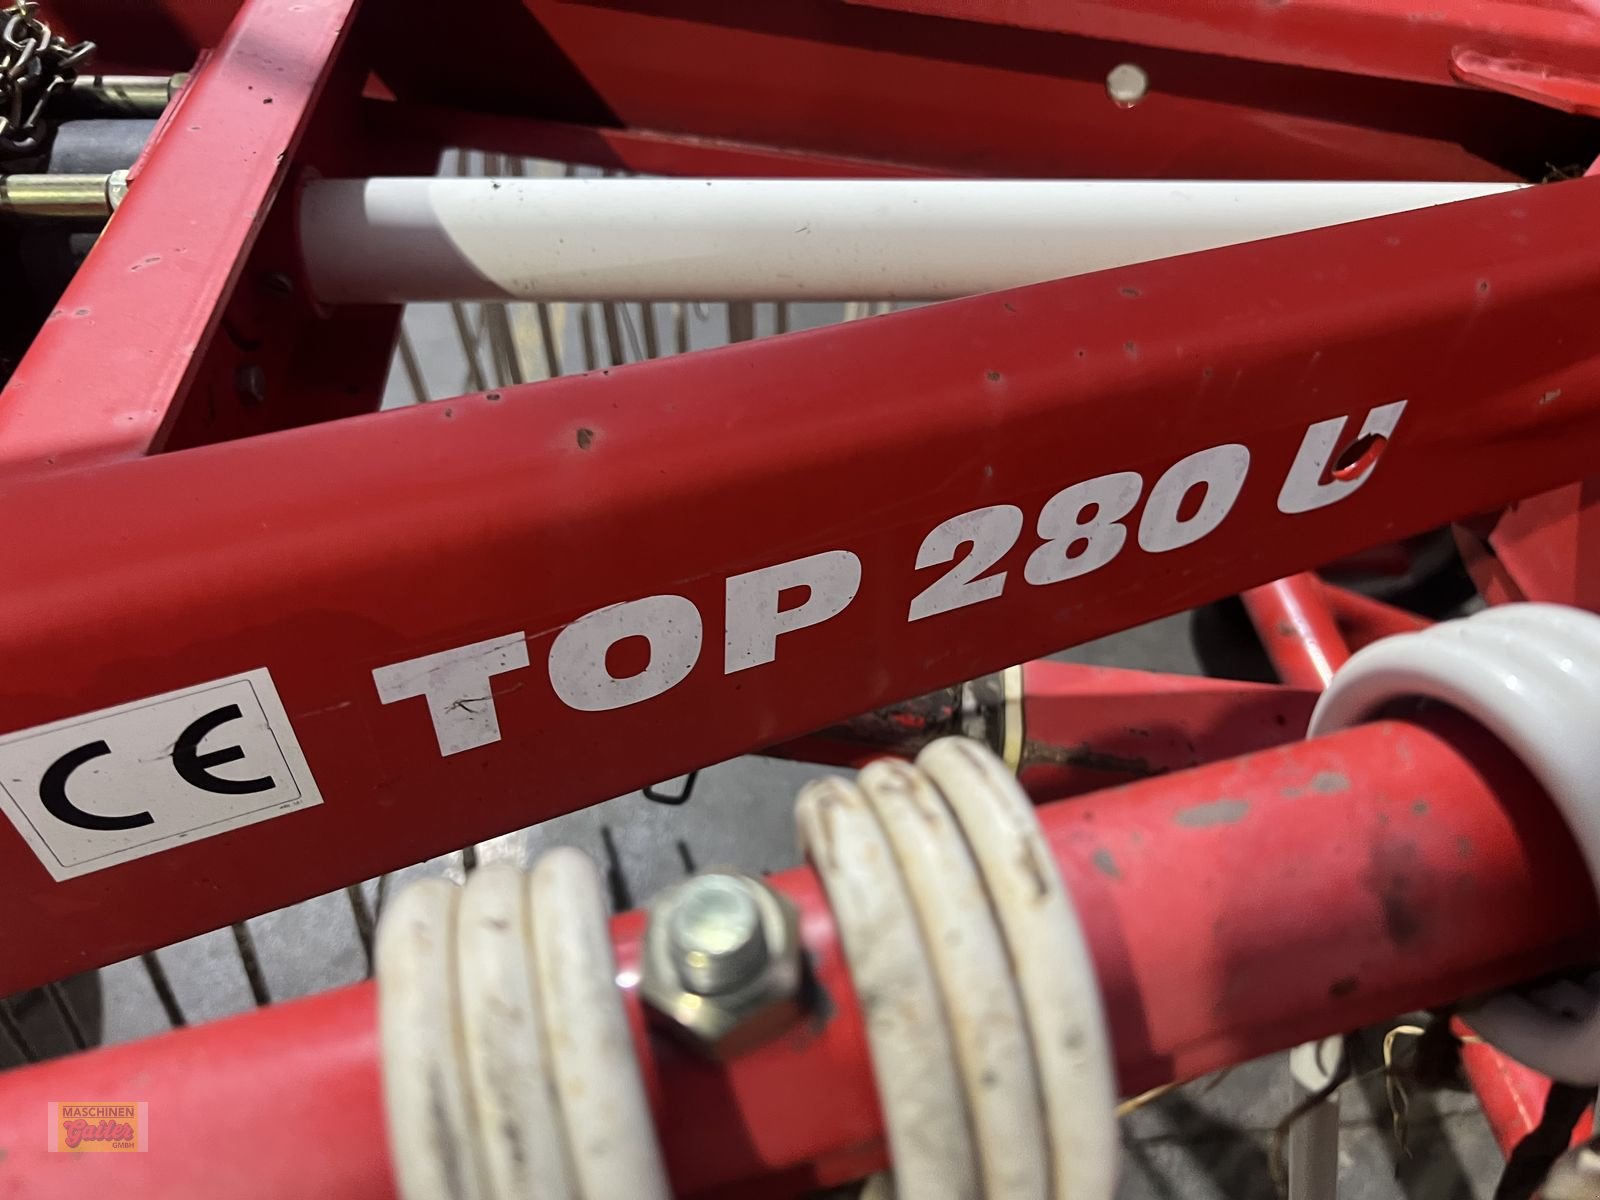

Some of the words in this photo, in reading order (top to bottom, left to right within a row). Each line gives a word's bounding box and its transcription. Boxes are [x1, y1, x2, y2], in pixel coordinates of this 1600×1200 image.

[372, 549, 862, 757] TOP
[907, 443, 1251, 623] 280
[1277, 400, 1408, 514] U
[39, 703, 276, 831] CE
